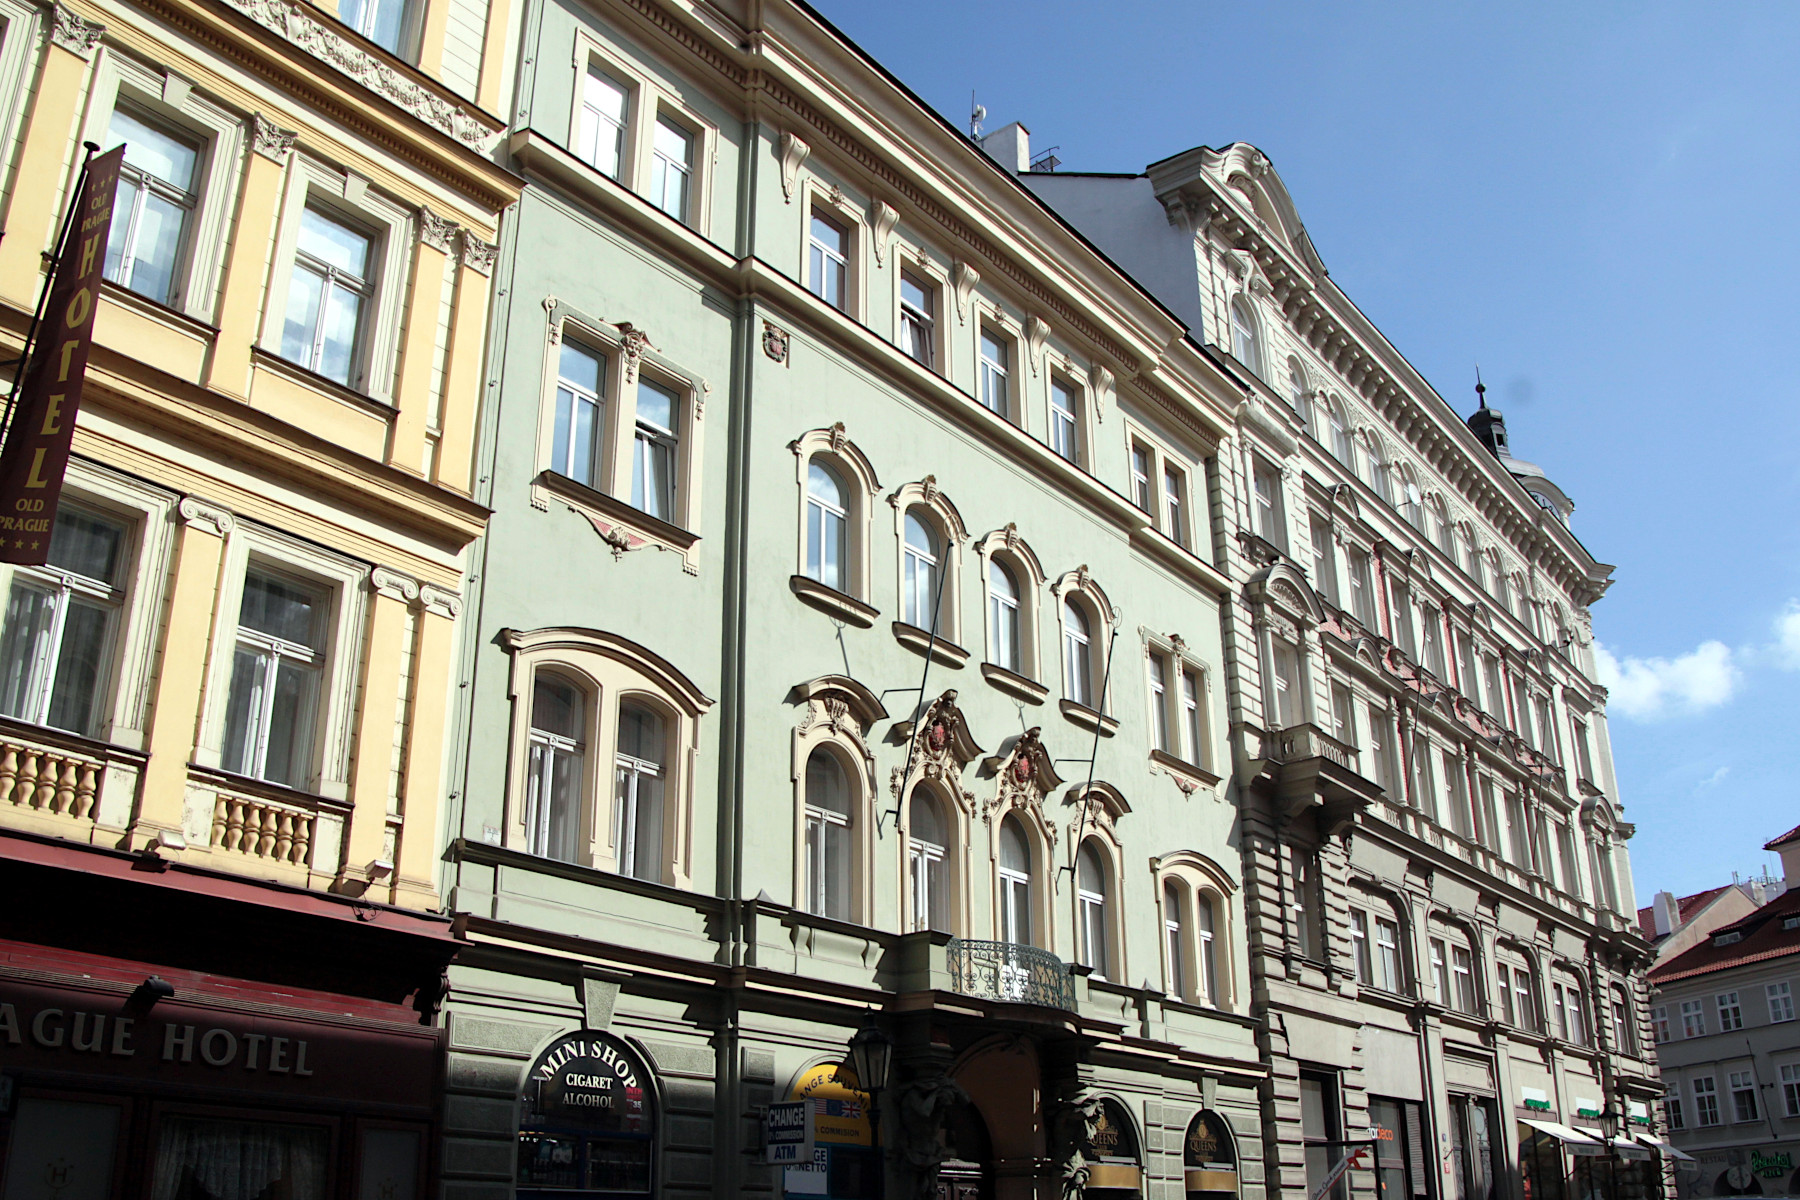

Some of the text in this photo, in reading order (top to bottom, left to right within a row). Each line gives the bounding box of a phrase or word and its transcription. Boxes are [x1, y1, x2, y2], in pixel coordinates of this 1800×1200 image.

[24, 233, 99, 488] HOTEL
[16, 499, 44, 512] OLD
[162, 1023, 313, 1076] HOTEL
[540, 1040, 638, 1088] MINI SHOP
[565, 1073, 615, 1090] CIGARET
[800, 1074, 824, 1099] ANGE
[562, 1092, 615, 1109] ALCOHOL
[768, 1106, 805, 1127] CHANGE
[775, 1145, 796, 1160] ATM
[1190, 1140, 1217, 1152] QUEENS
[1701, 1154, 1728, 1164] RESTAU
